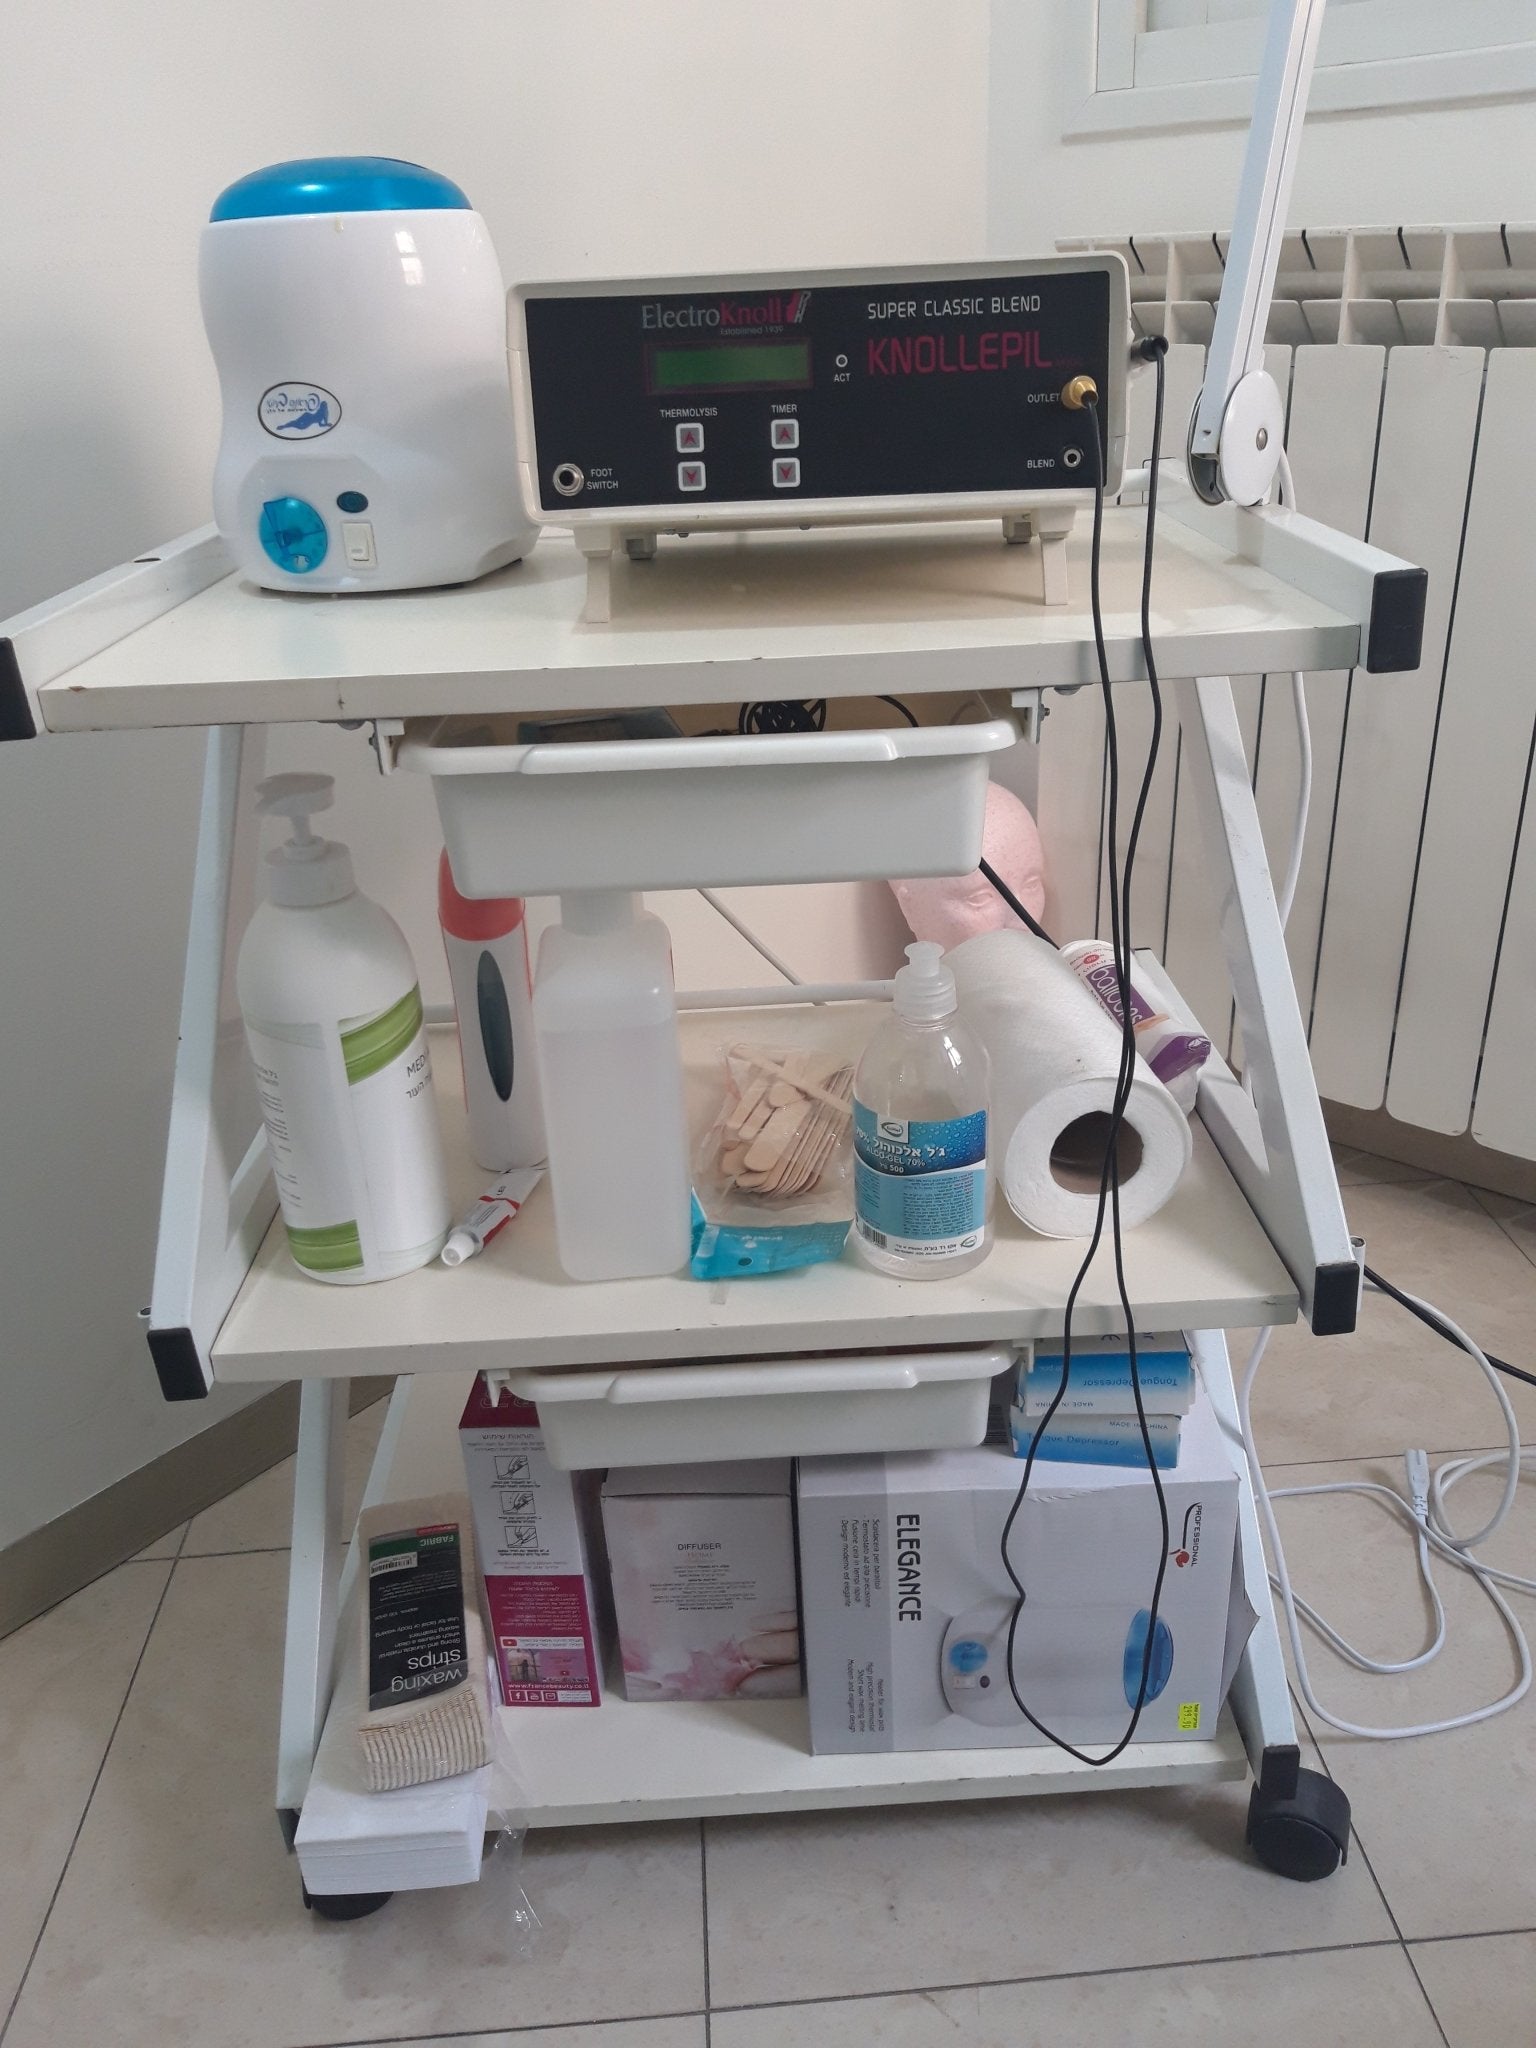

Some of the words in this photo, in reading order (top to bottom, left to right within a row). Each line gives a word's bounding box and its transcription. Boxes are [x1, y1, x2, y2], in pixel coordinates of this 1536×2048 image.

[641, 297, 783, 329] ElectroKnoll
[867, 301, 918, 320] SUPER
[923, 298, 984, 317] CLASSIC
[991, 295, 1041, 314] BLEND
[867, 331, 1053, 376] KNOLLEPIL
[834, 373, 851, 383] ACT
[1027, 393, 1060, 404] OUTLET
[659, 407, 719, 418] THERMOLYSIS
[771, 404, 798, 414] TIMER
[1027, 459, 1055, 469] BLEND
[590, 468, 613, 477] FOOT
[586, 481, 619, 490] SWITCH
[874, 1137, 922, 1157] אלכוהול
[908, 1159, 926, 1167] 70%
[890, 1165, 904, 1173] 500
[1083, 1377, 1134, 1386] Depressor
[1140, 1377, 1177, 1386] Tongue
[1067, 1434, 1120, 1446] Depressor
[419, 1534, 455, 1547] FABRIC
[1190, 1504, 1203, 1568] PROFESSIONAL
[677, 1543, 722, 1551] DIFFUSER
[896, 1514, 922, 1622] ELEGANCE
[407, 1649, 461, 1671] strips
[391, 1668, 462, 1694] waxing
